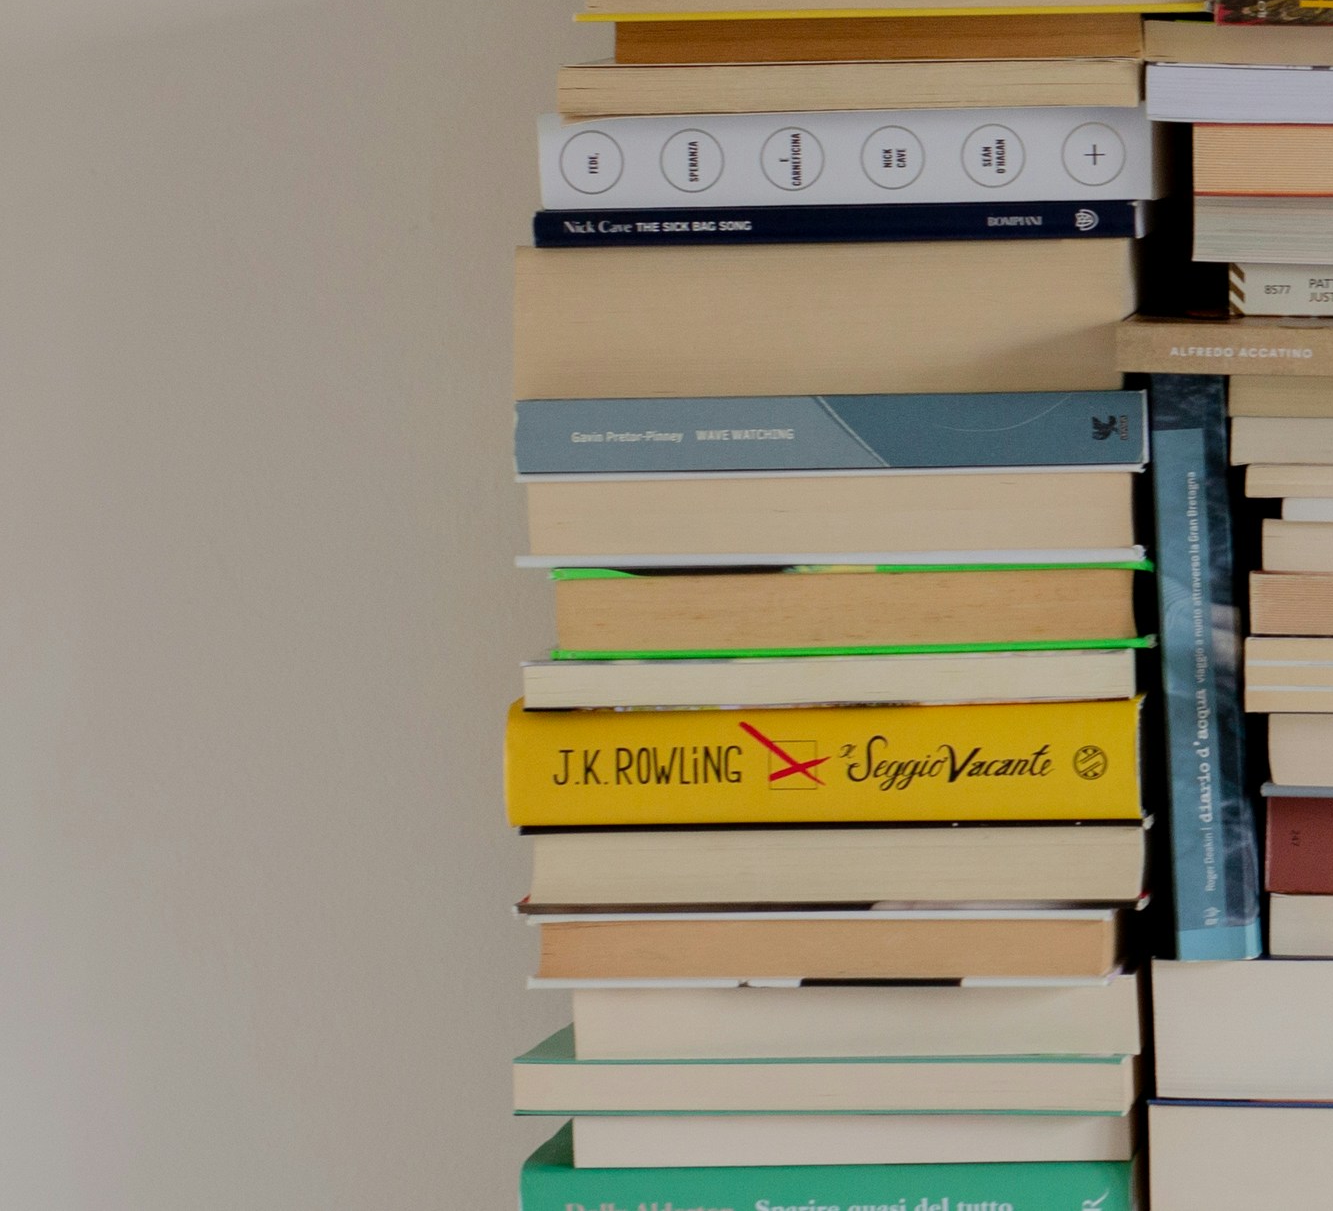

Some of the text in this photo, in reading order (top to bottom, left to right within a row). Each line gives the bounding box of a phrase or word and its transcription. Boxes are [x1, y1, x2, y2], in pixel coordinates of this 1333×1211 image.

[588, 152, 600, 175] FEDE,
[688, 140, 699, 183] SPERANZA
[791, 132, 802, 187] CARNEFICINA
[882, 148, 893, 169] NICK
[896, 148, 907, 169] CAVE
[982, 146, 992, 167] SEAN
[996, 138, 1006, 174] O'HAGAN
[563, 220, 634, 234] Nick Cave
[635, 220, 753, 233] THE SICK BAG SONG
[986, 216, 1043, 228] BOMPIANI
[1264, 284, 1292, 295] 8577
[1169, 346, 1313, 360] ALFREDO ACCATINO
[571, 431, 603, 443] Gavin
[695, 428, 796, 441] WAVE WATCHING
[1186, 471, 1199, 518] Bretagna
[1188, 521, 1200, 542] Gran
[1189, 555, 1203, 603] attraverso
[1193, 606, 1204, 637] nuoto
[1194, 646, 1208, 683] viaggio
[847, 734, 948, 792] Seggio
[936, 743, 1058, 784] Vacante
[1192, 687, 1214, 824] diario d'acqua
[1203, 831, 1219, 892] Roger Deakin
